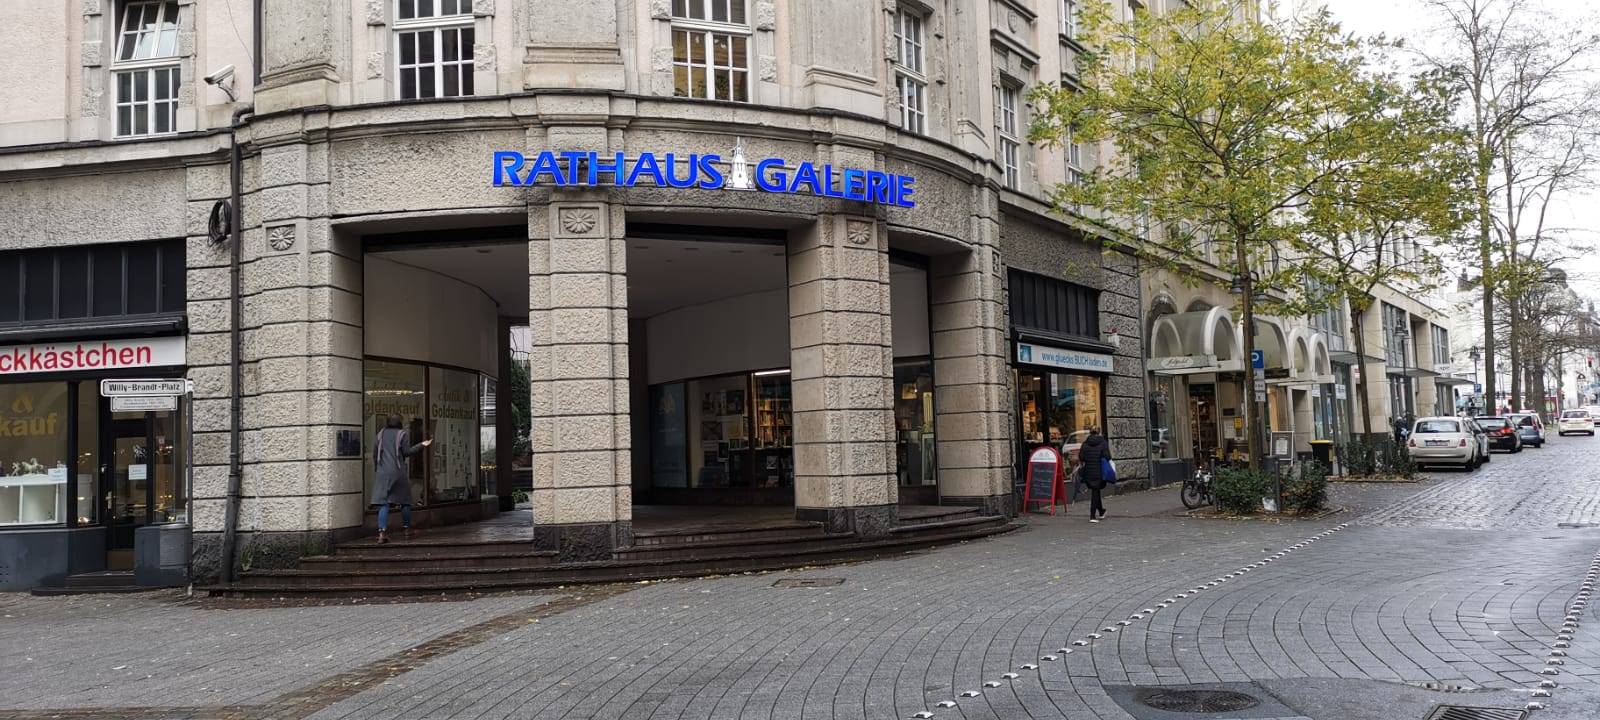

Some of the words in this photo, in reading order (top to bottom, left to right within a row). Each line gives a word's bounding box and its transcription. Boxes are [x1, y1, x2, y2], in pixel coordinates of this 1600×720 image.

[493, 150, 724, 189] RATHAUS
[756, 158, 916, 208] GALERIE
[0, 343, 152, 372] ckkästchen
[108, 383, 180, 392] Willy-Brandt-Platz
[365, 401, 420, 416] oldankauf
